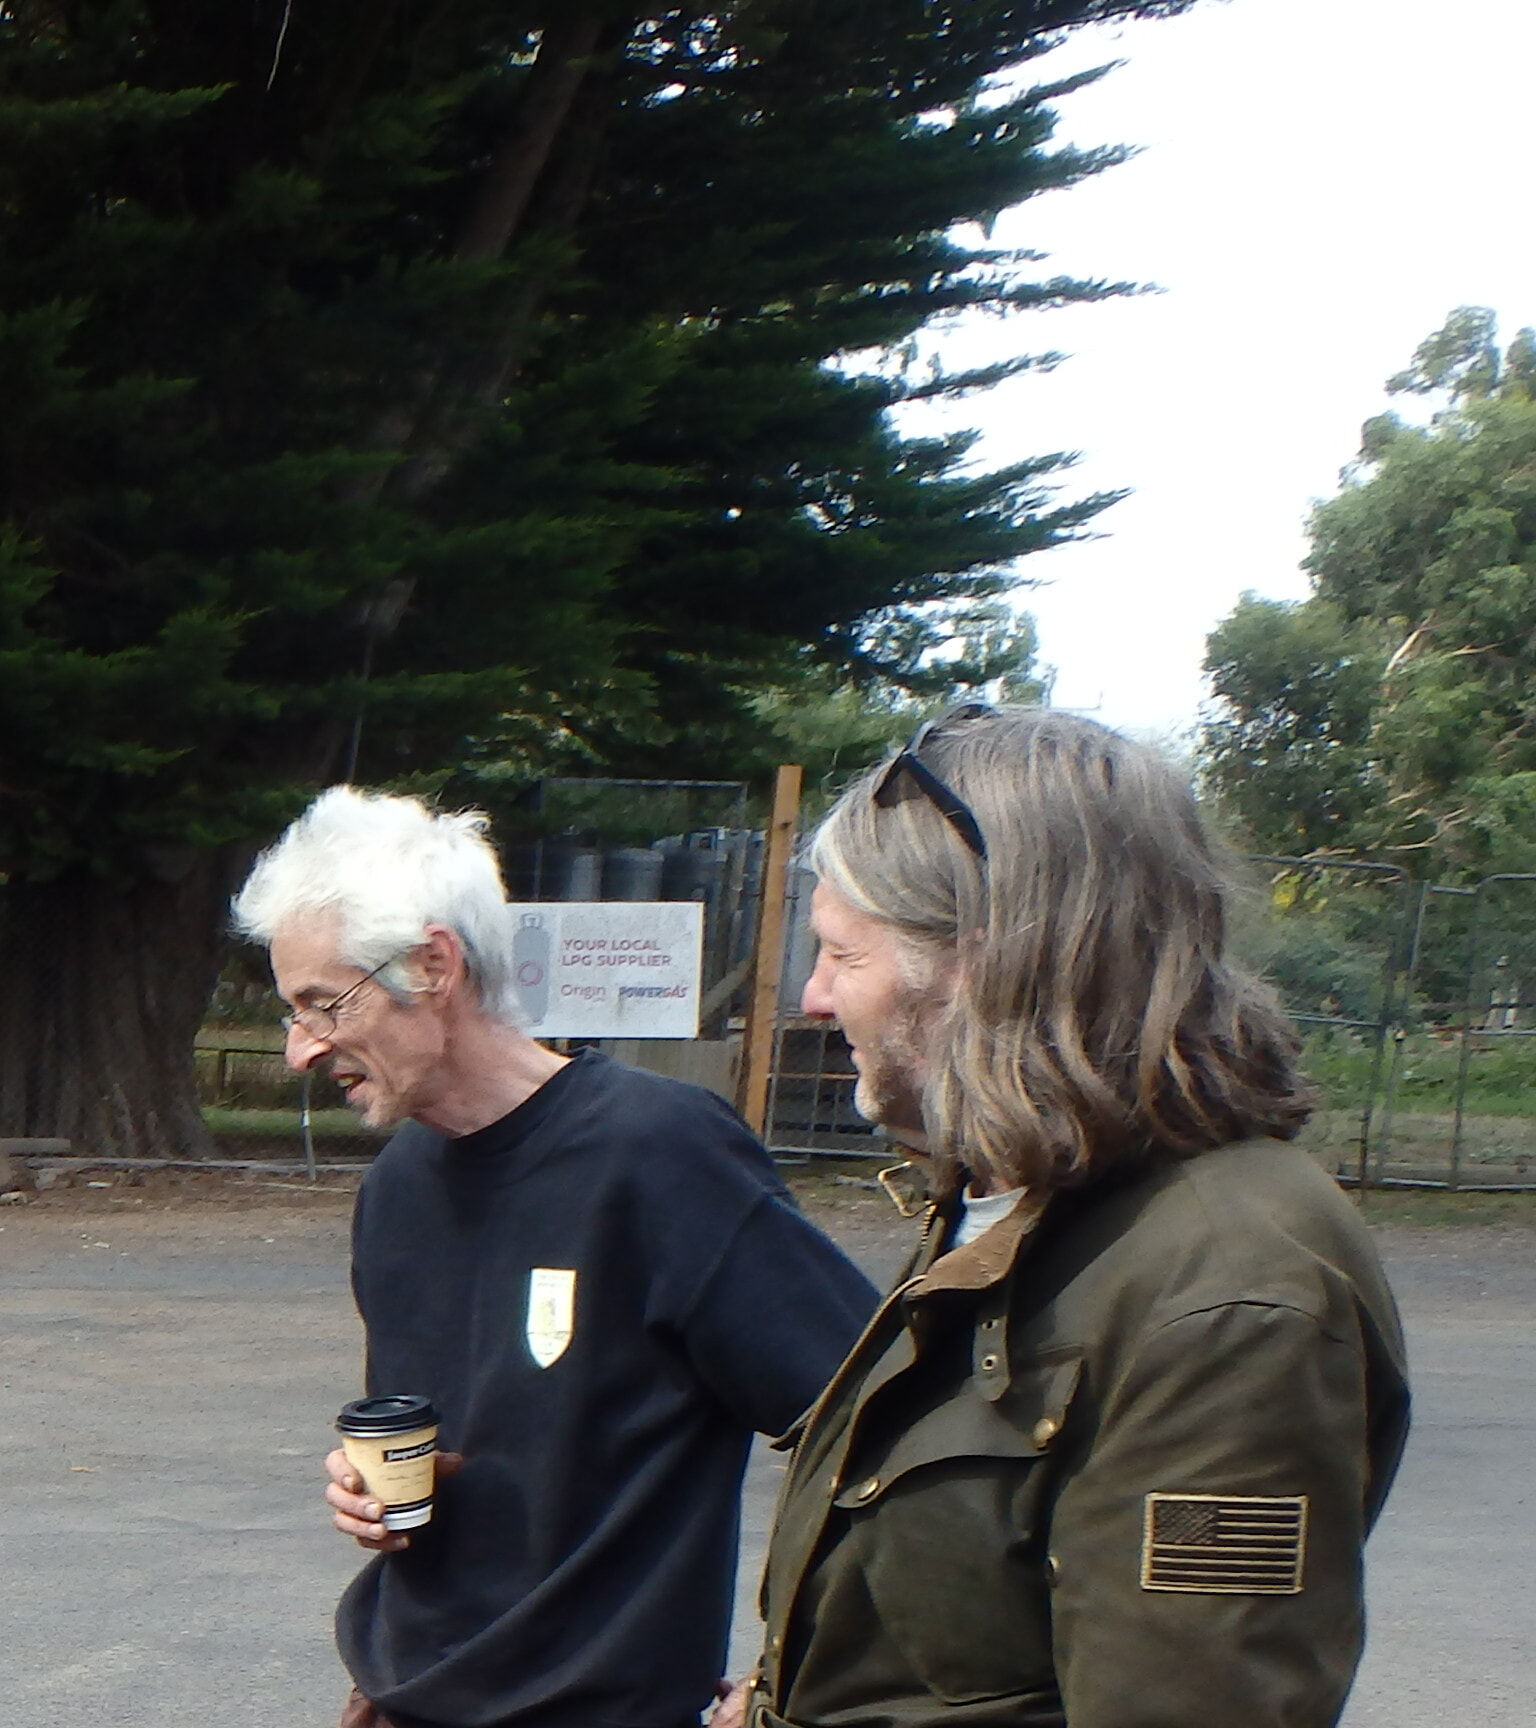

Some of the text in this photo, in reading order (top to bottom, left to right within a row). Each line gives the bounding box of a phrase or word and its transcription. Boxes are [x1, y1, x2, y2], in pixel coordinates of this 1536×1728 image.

[562, 939, 662, 951] YOUR LOCAL
[561, 954, 672, 967] LPG SUPPLIER
[561, 984, 606, 1000] Origin
